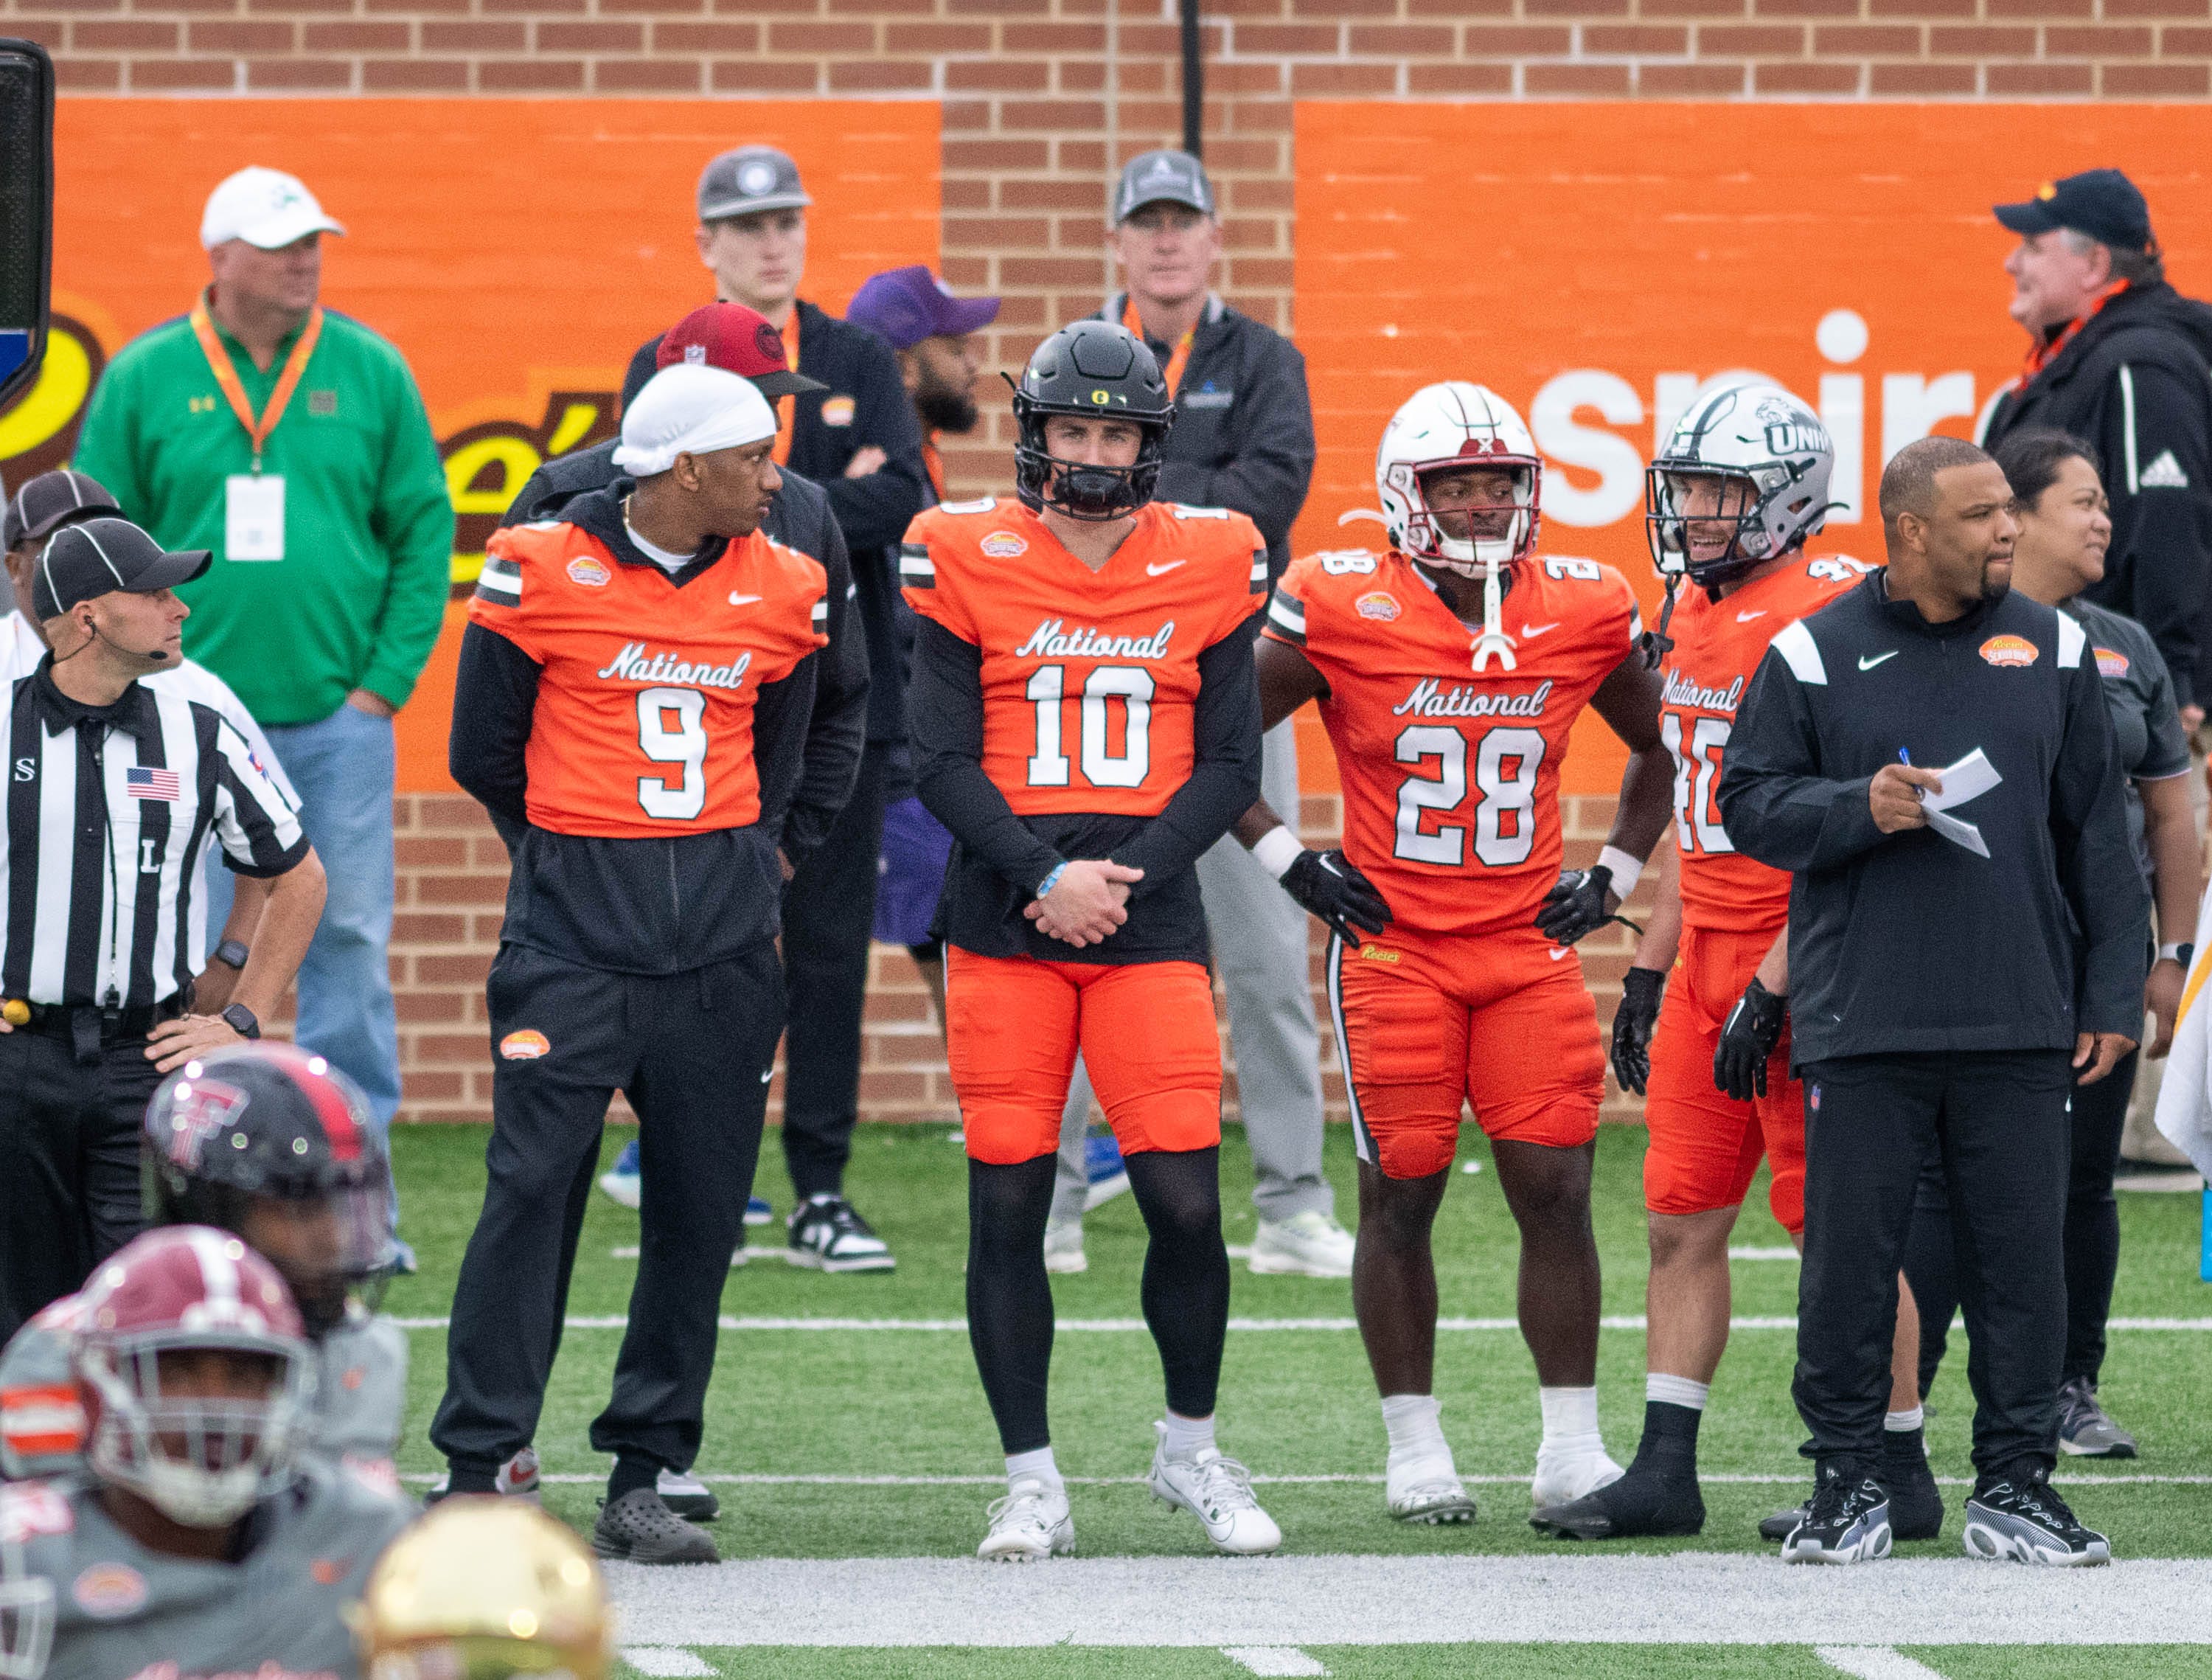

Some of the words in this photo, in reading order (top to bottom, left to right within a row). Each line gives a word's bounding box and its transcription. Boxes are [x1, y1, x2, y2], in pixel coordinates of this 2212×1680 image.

[1015, 619, 1175, 659] National
[597, 641, 752, 689] National
[1392, 676, 1554, 717] National
[1660, 667, 1745, 712] National
[1026, 664, 1157, 788] 10
[15, 758, 35, 782] S
[636, 685, 708, 820] 9
[1393, 724, 1547, 867] 28
[141, 839, 160, 873] L
